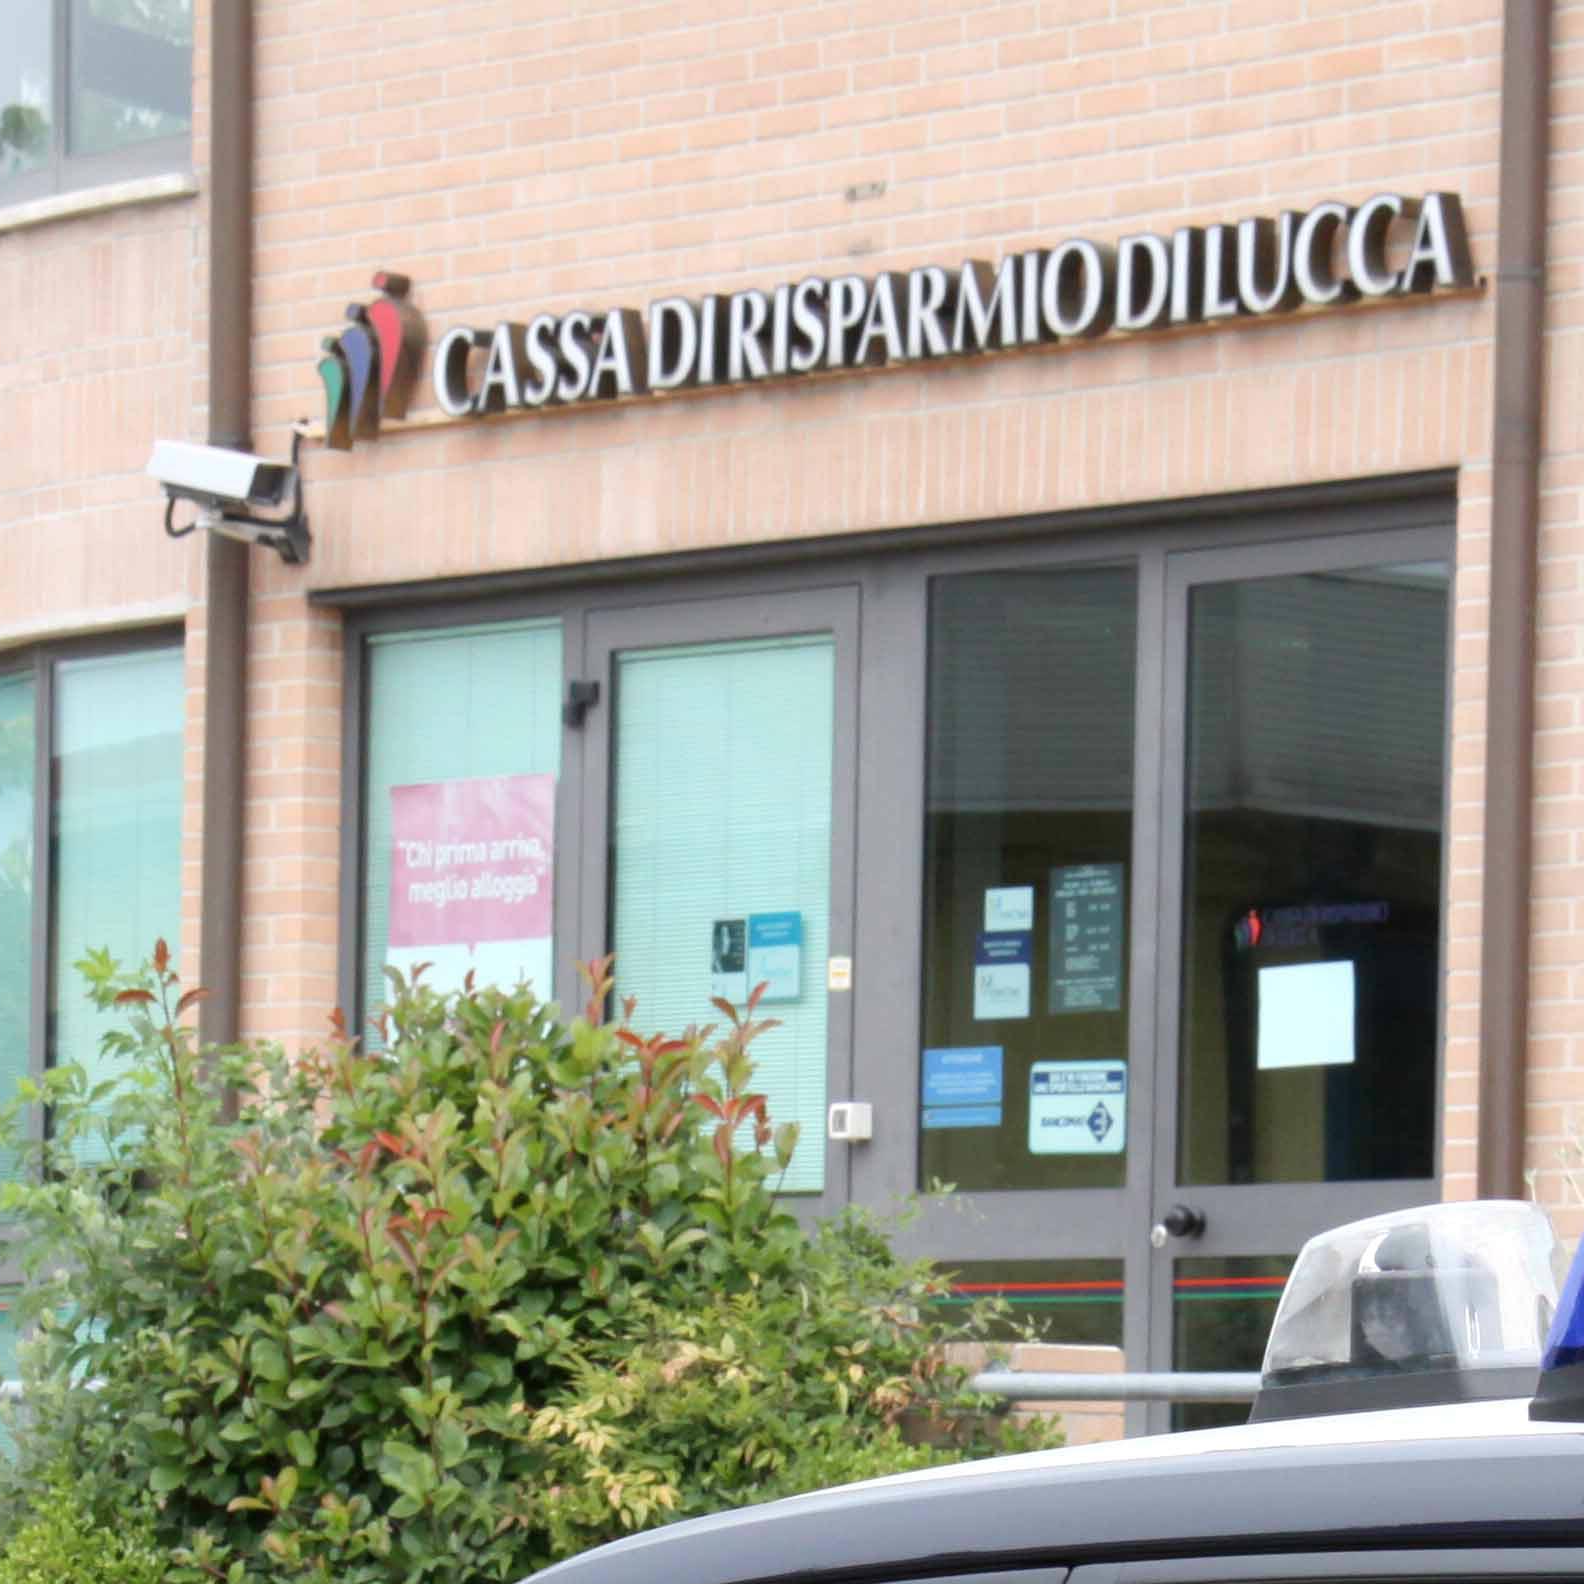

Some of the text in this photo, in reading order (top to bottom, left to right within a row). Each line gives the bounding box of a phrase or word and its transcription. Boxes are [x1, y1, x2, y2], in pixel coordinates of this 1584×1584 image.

[432, 192, 1456, 417] CASSA DI RISPARMIO DI LUCCA
